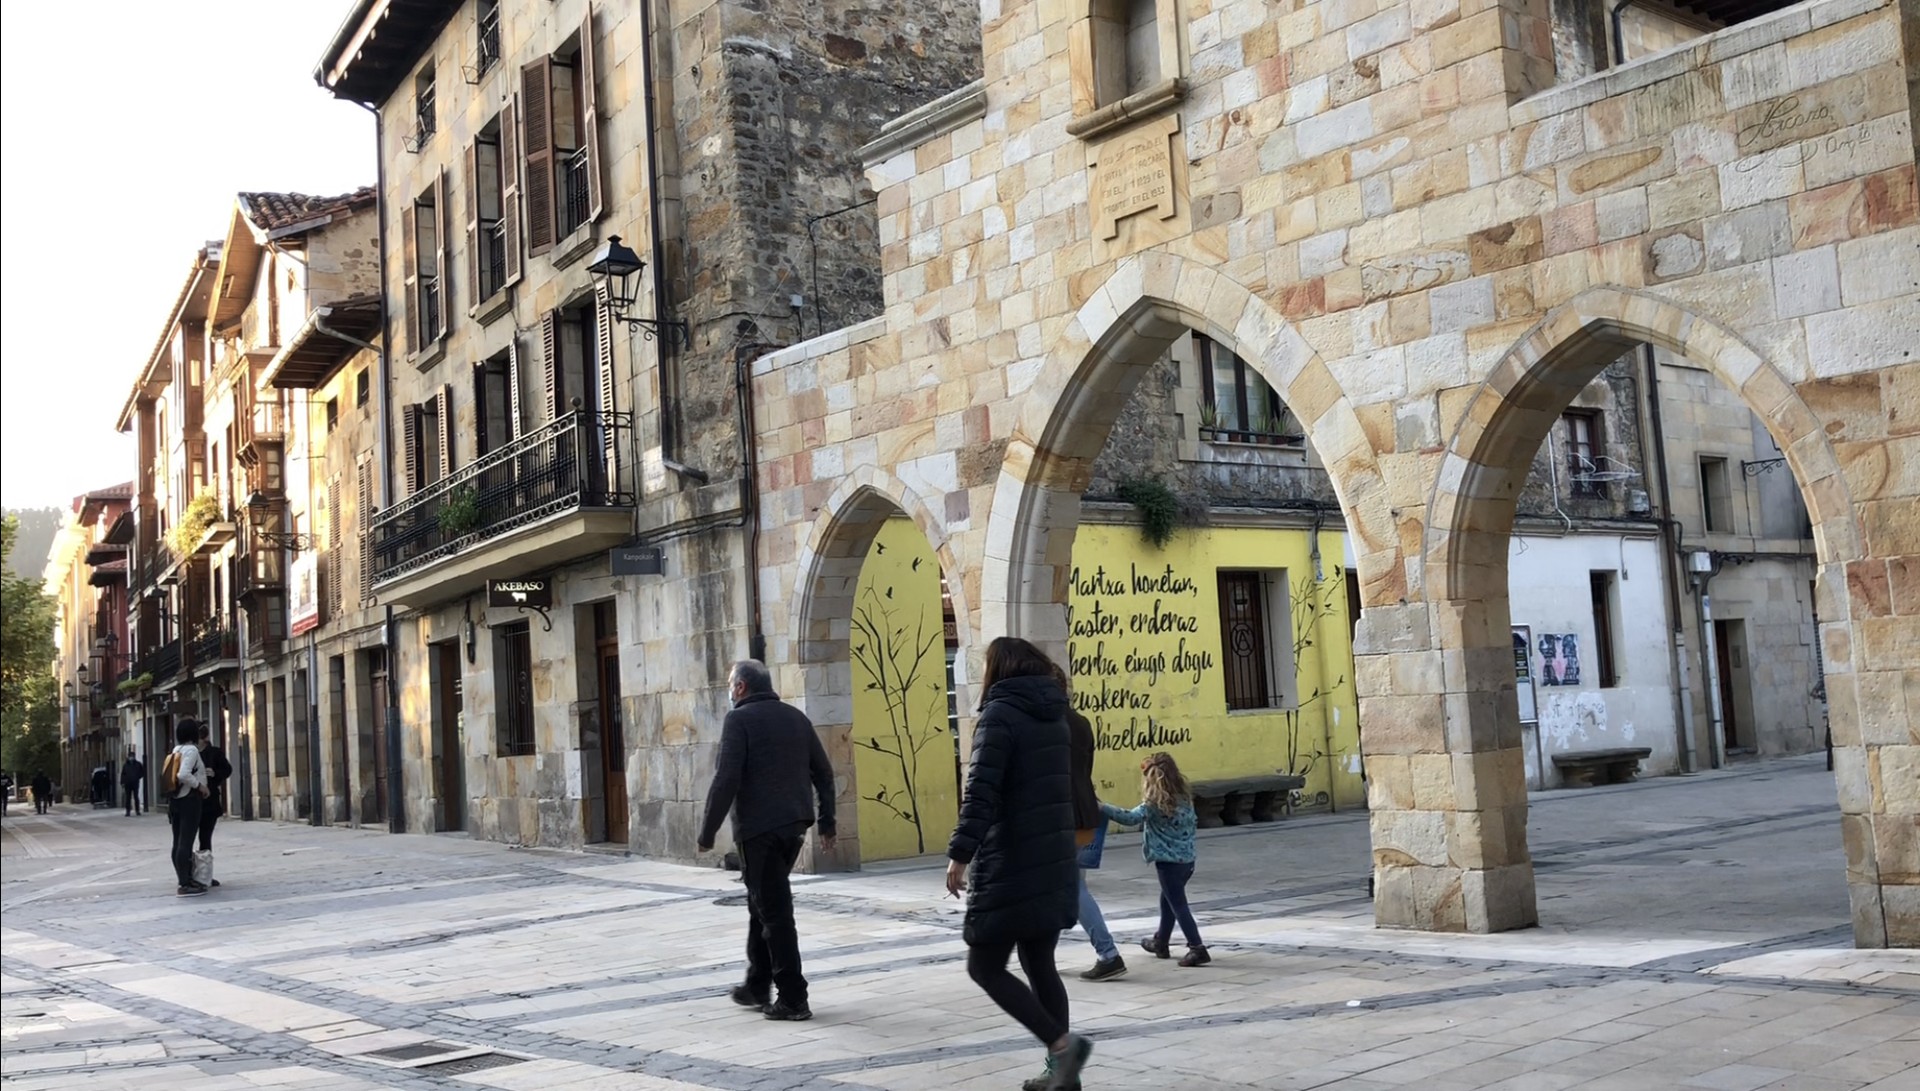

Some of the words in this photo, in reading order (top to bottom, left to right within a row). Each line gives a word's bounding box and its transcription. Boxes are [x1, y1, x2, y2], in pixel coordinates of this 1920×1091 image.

[494, 581, 545, 592] AKEBASO
[1131, 562, 1198, 598] honetan,
[1130, 598, 1199, 635] erderaz
[1069, 641, 1119, 676] berba
[1124, 647, 1166, 687] eingo
[1172, 637, 1214, 685] dogu
[1072, 679, 1152, 713] euskeraz
[1094, 715, 1192, 751] bizelakuan
